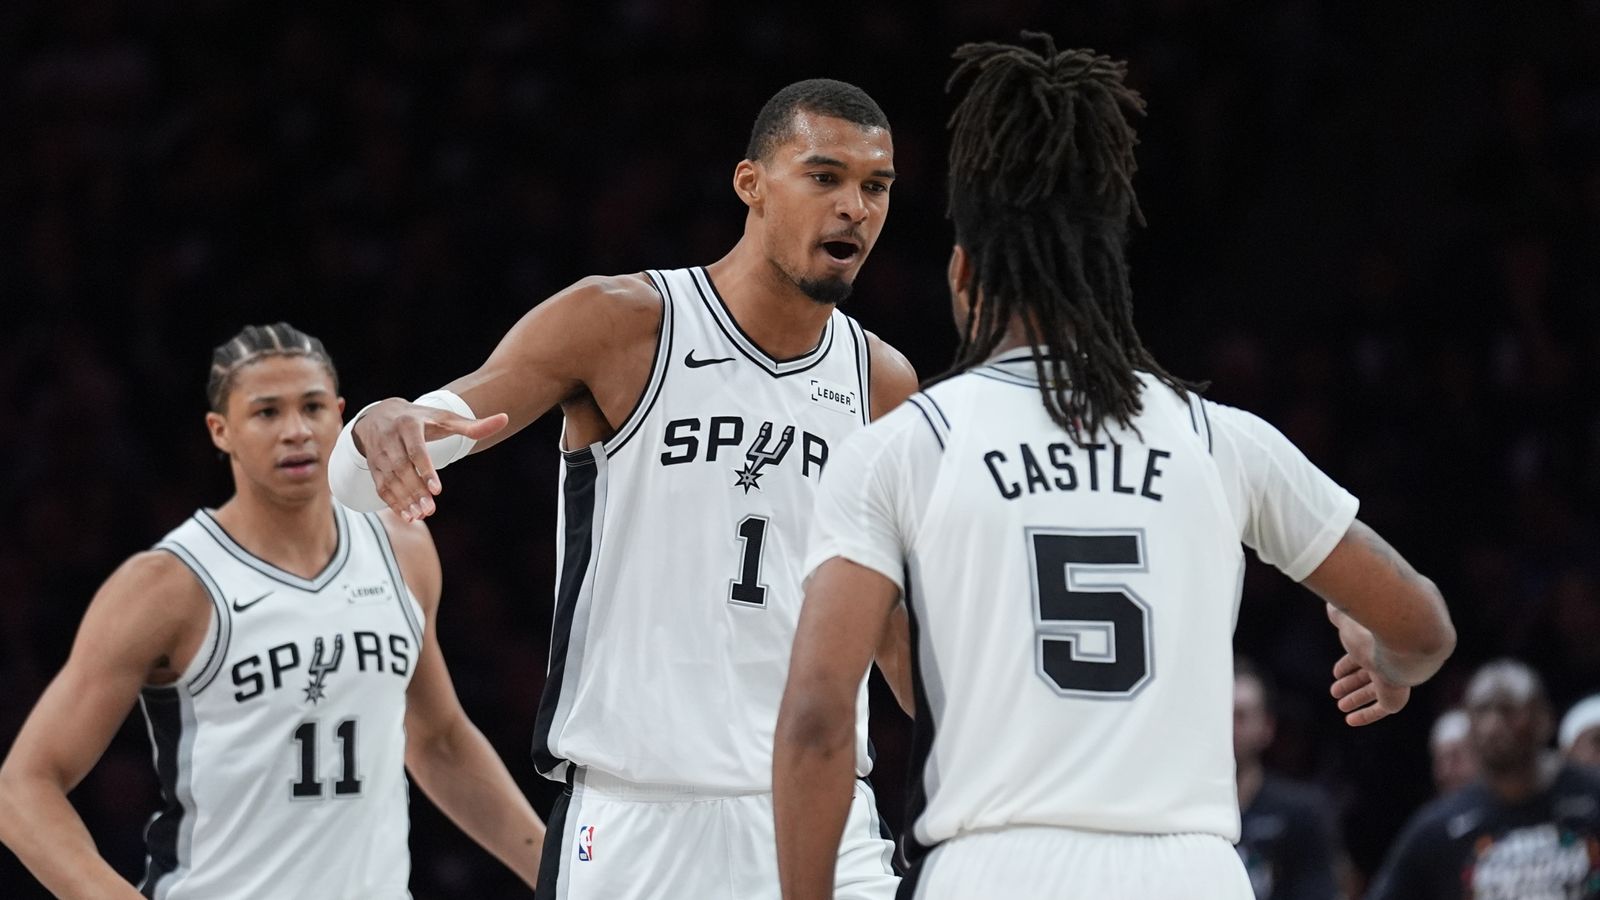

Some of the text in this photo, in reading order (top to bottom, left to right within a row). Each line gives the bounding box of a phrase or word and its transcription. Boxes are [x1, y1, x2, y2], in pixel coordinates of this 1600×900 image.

[816, 386, 851, 406] LEDGER
[660, 416, 829, 495] SPUR
[983, 443, 1171, 502] CASTLE
[727, 513, 770, 609] 1
[1024, 526, 1156, 701] 5
[231, 631, 409, 704] SPURS
[290, 716, 364, 801] 11
